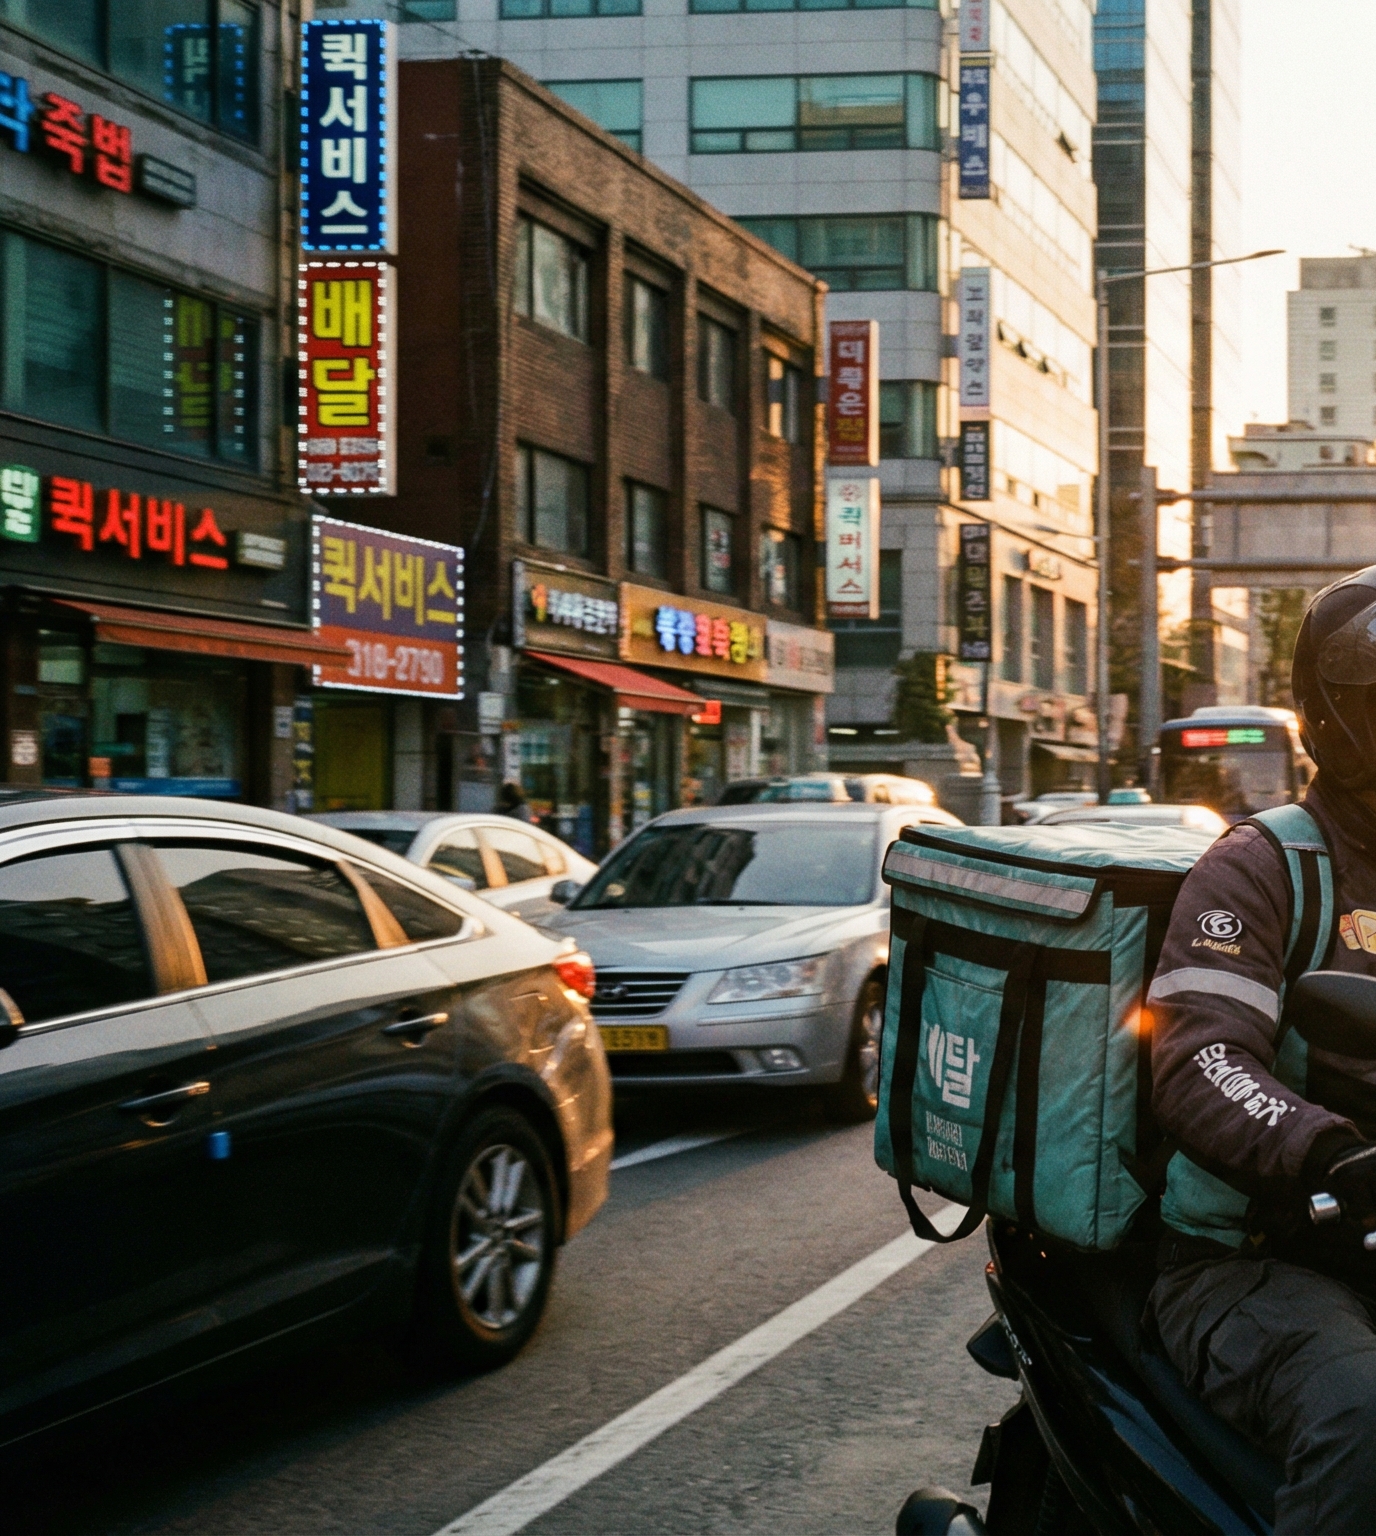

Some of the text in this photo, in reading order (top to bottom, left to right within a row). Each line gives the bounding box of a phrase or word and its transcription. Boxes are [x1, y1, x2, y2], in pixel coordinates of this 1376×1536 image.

[319, 32, 370, 235] 퀵서비스
[311, 279, 376, 427] 배달
[50, 475, 230, 570] 퀵서비스
[322, 536, 457, 627] 퀵서비스
